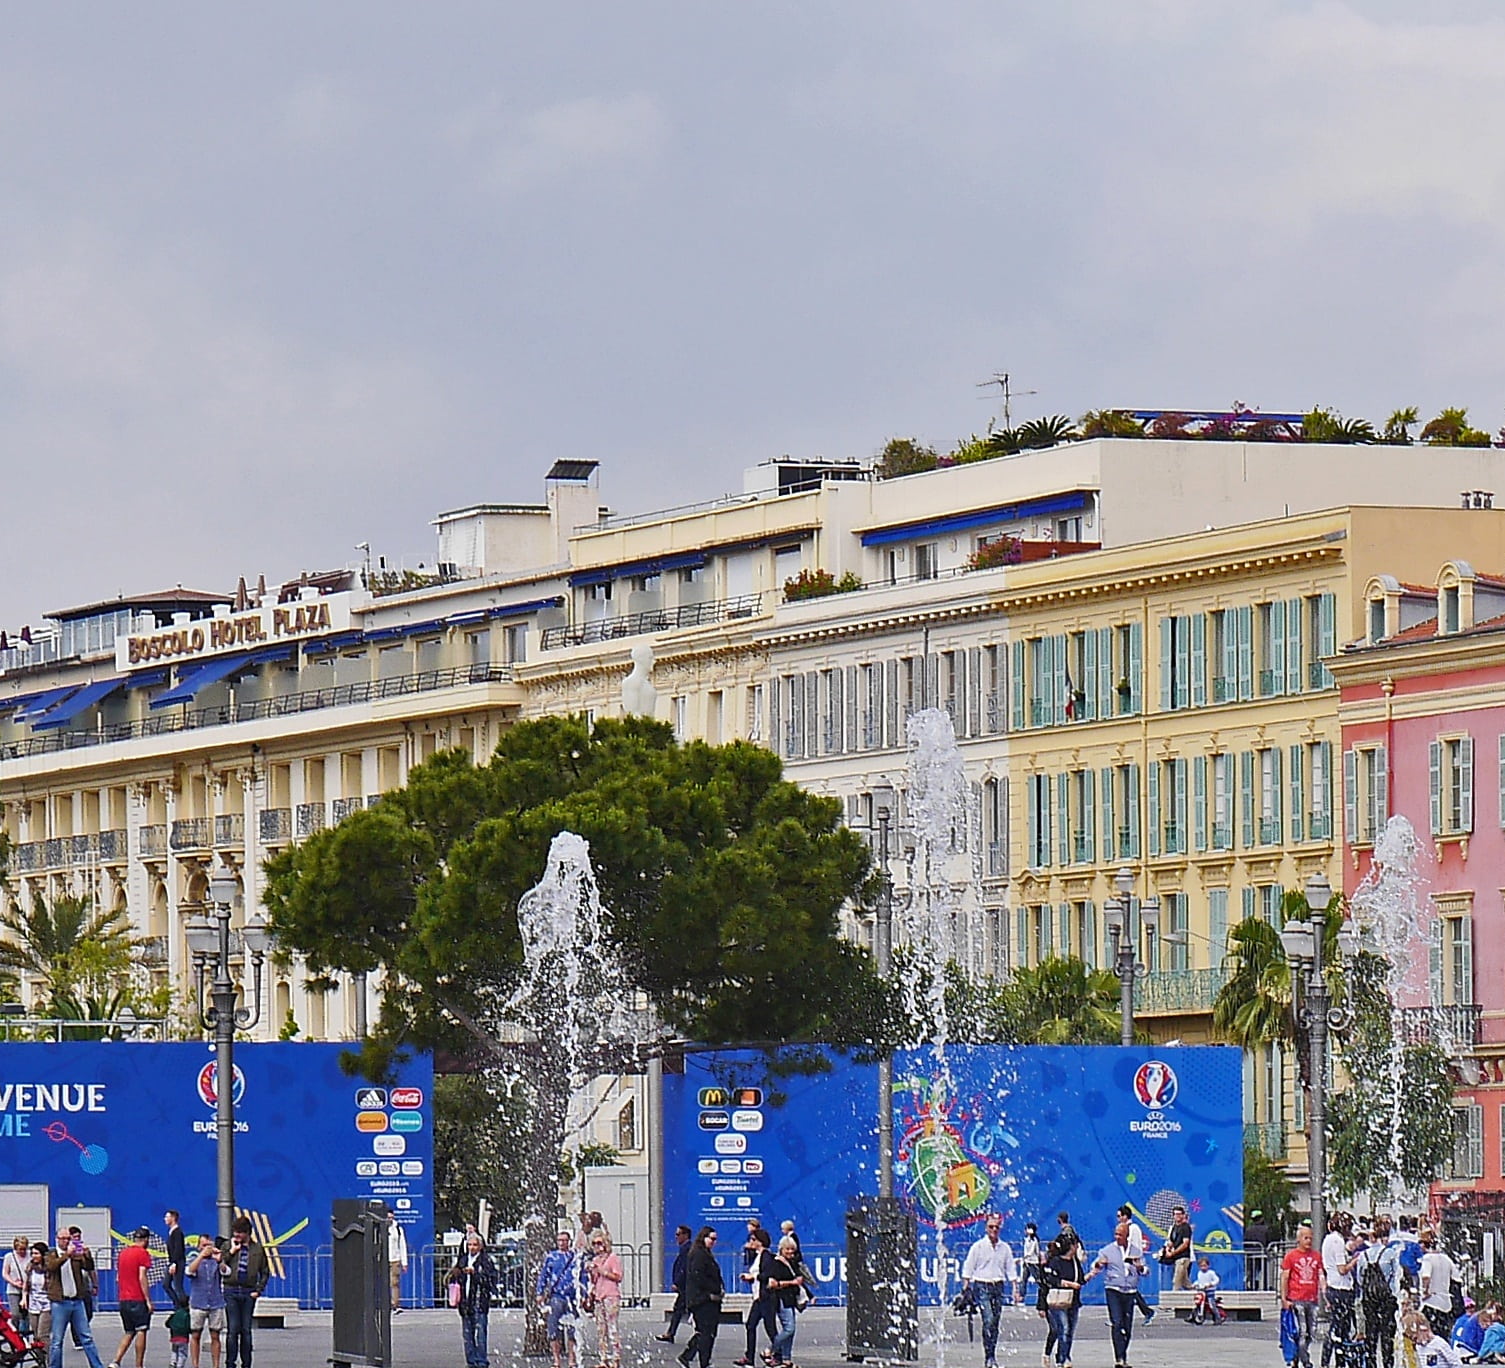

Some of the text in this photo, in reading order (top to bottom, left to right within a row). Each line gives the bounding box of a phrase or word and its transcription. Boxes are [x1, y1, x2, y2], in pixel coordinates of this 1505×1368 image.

[128, 602, 331, 663] BOSCOLO HOTEL PLAZA
[1129, 1120, 1182, 1132] EURO2016
